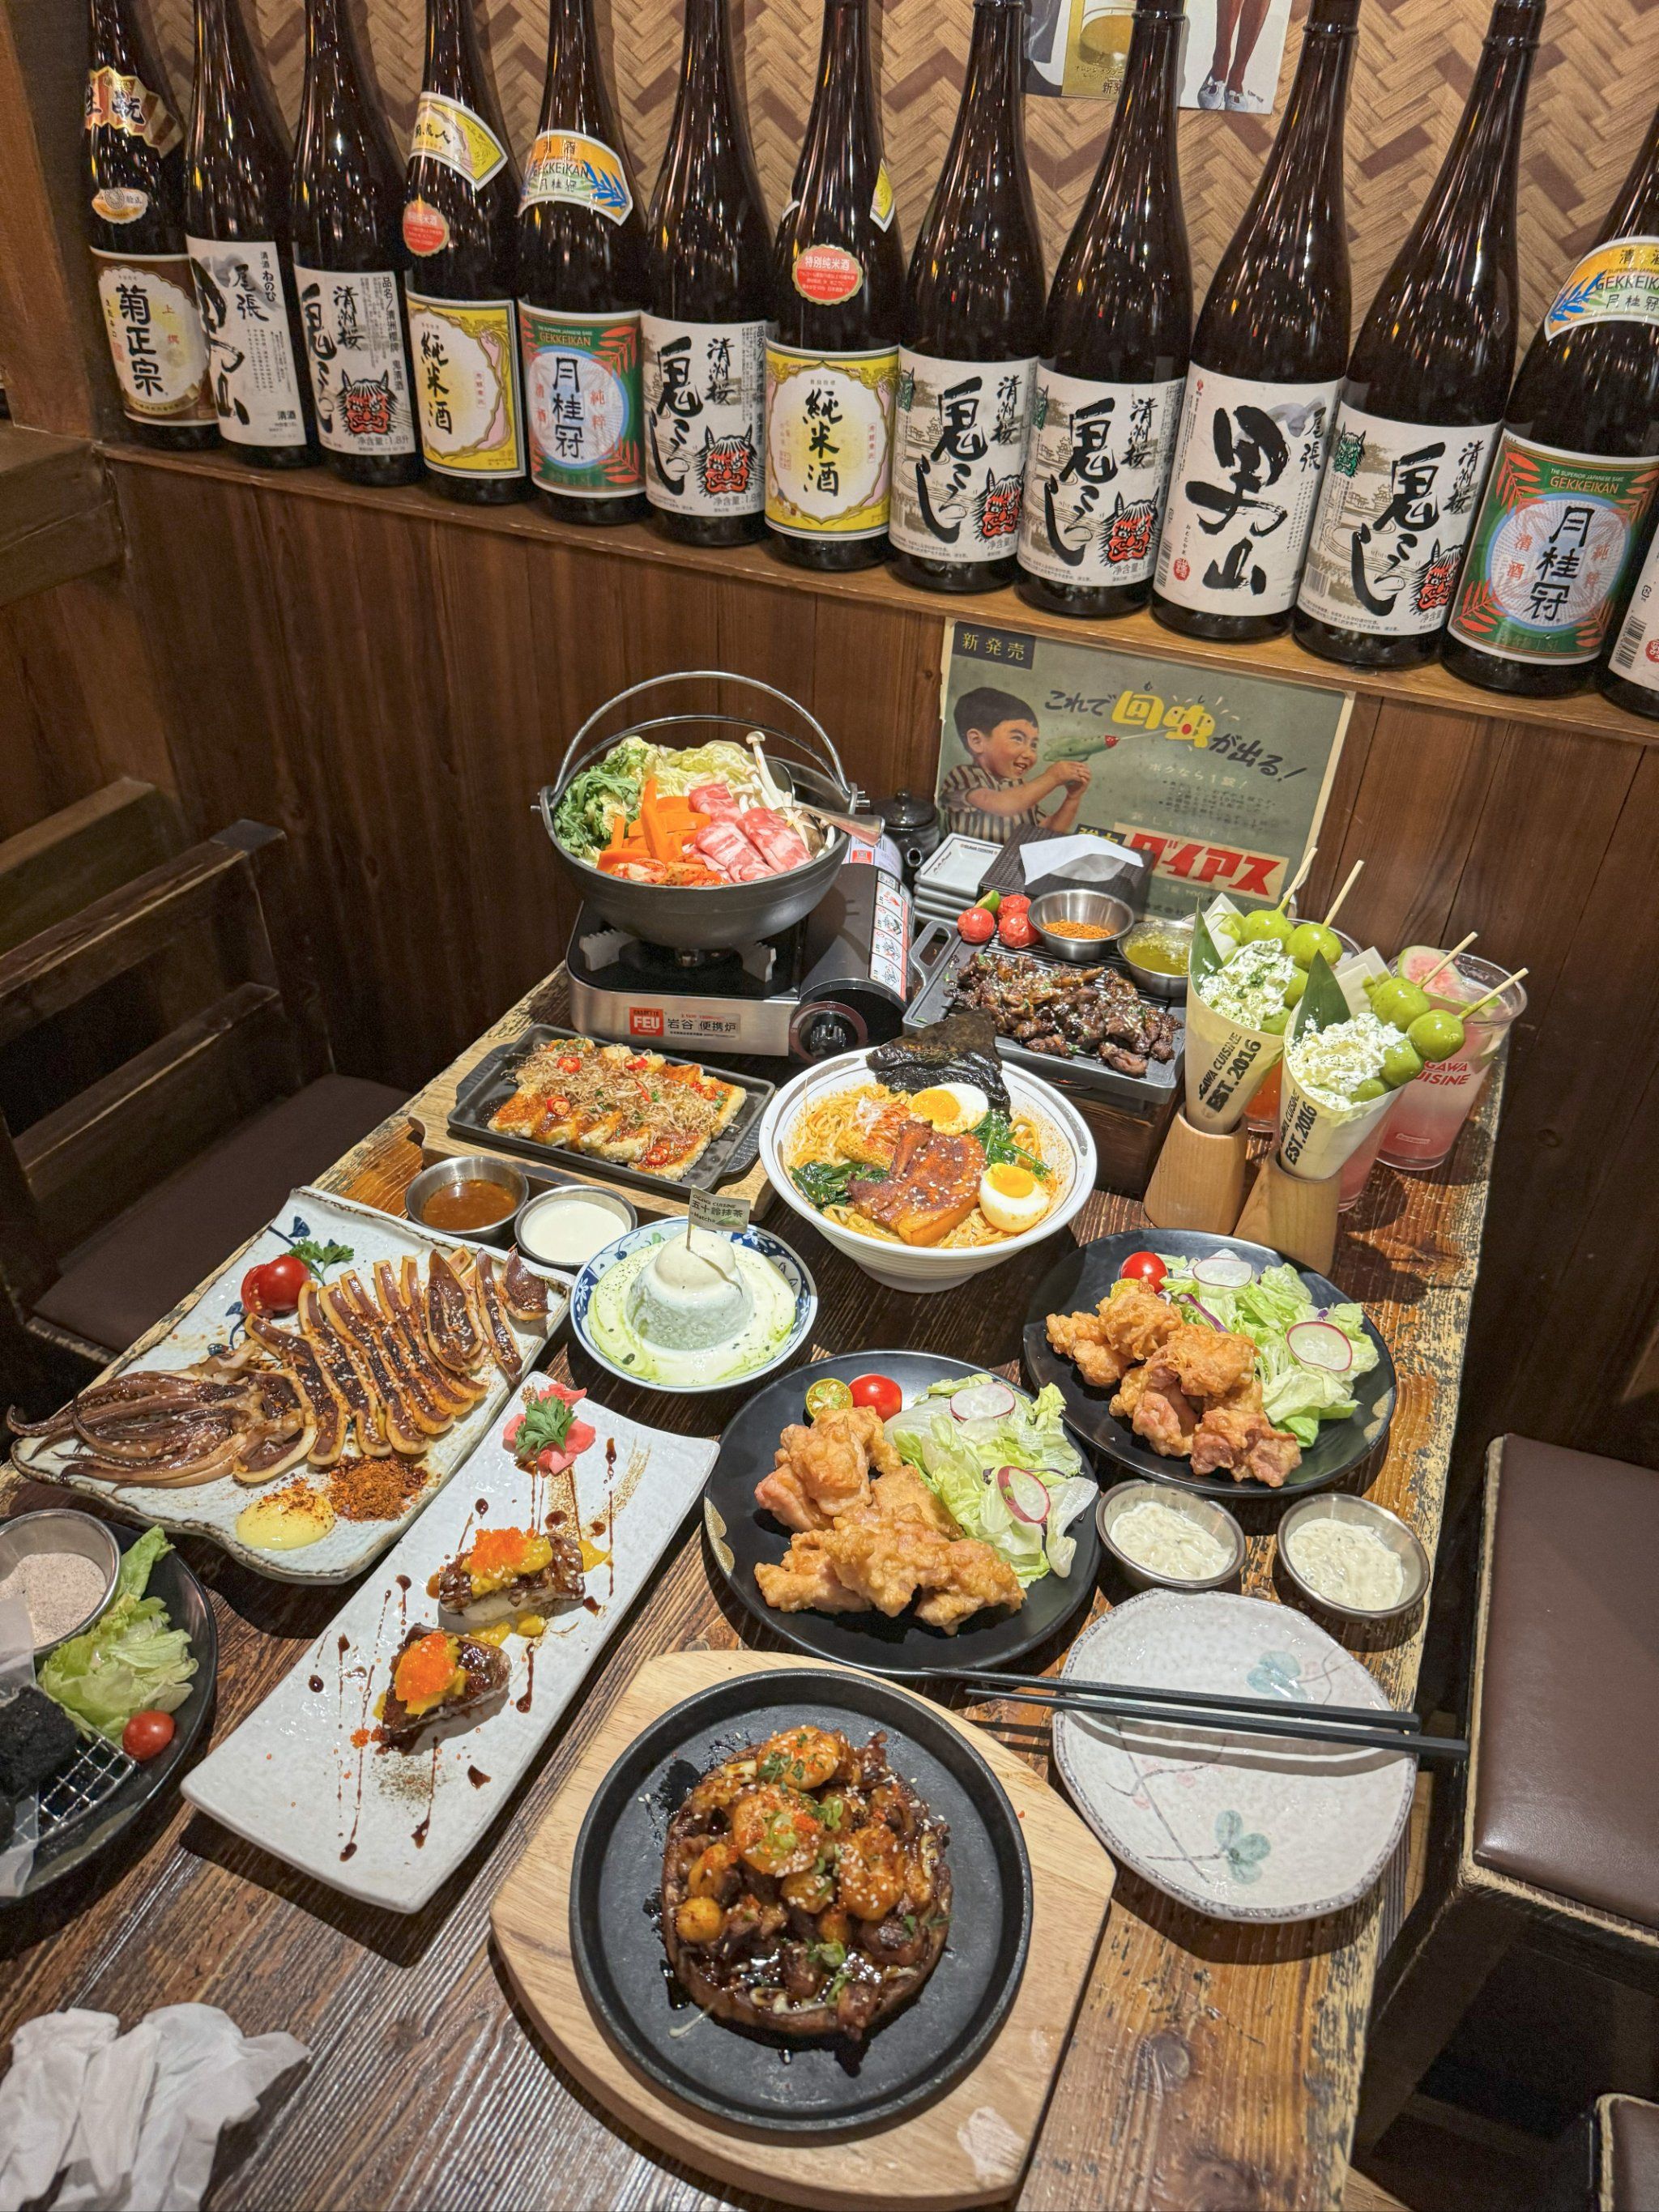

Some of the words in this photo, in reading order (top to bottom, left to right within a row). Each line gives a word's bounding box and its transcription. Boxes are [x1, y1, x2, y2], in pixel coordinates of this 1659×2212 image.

[805, 255, 850, 271] 特别纯米酒
[232, 263, 270, 322] 尾張
[262, 271, 276, 302] ねのび
[116, 283, 164, 397] 菊正宗
[539, 331, 591, 347] GEKKEIKAN
[420, 331, 452, 435] 純米酒
[552, 356, 584, 459] 月桂冠
[802, 388, 842, 497] 純米酒
[1299, 407, 1327, 471] 尾張
[1550, 475, 1619, 494] GEKKEIKAN
[1561, 470, 1586, 479] SUPERIOR
[1185, 405, 1291, 595] 男山
[1507, 532, 1533, 581] 清酒
[1523, 505, 1595, 621] 月桂冠
[962, 633, 1025, 661] 新発売
[634, 1016, 659, 1029] FEU
[667, 1018, 693, 1030] 岩谷
[699, 1021, 736, 1032] 便携炉
[1213, 1032, 1242, 1071] CUISINE
[1423, 1060, 1469, 1072] GAWA
[1206, 1039, 1261, 1113] EST.2016
[1415, 1071, 1471, 1085] UISINE
[1284, 1102, 1317, 1166] EST.2016
